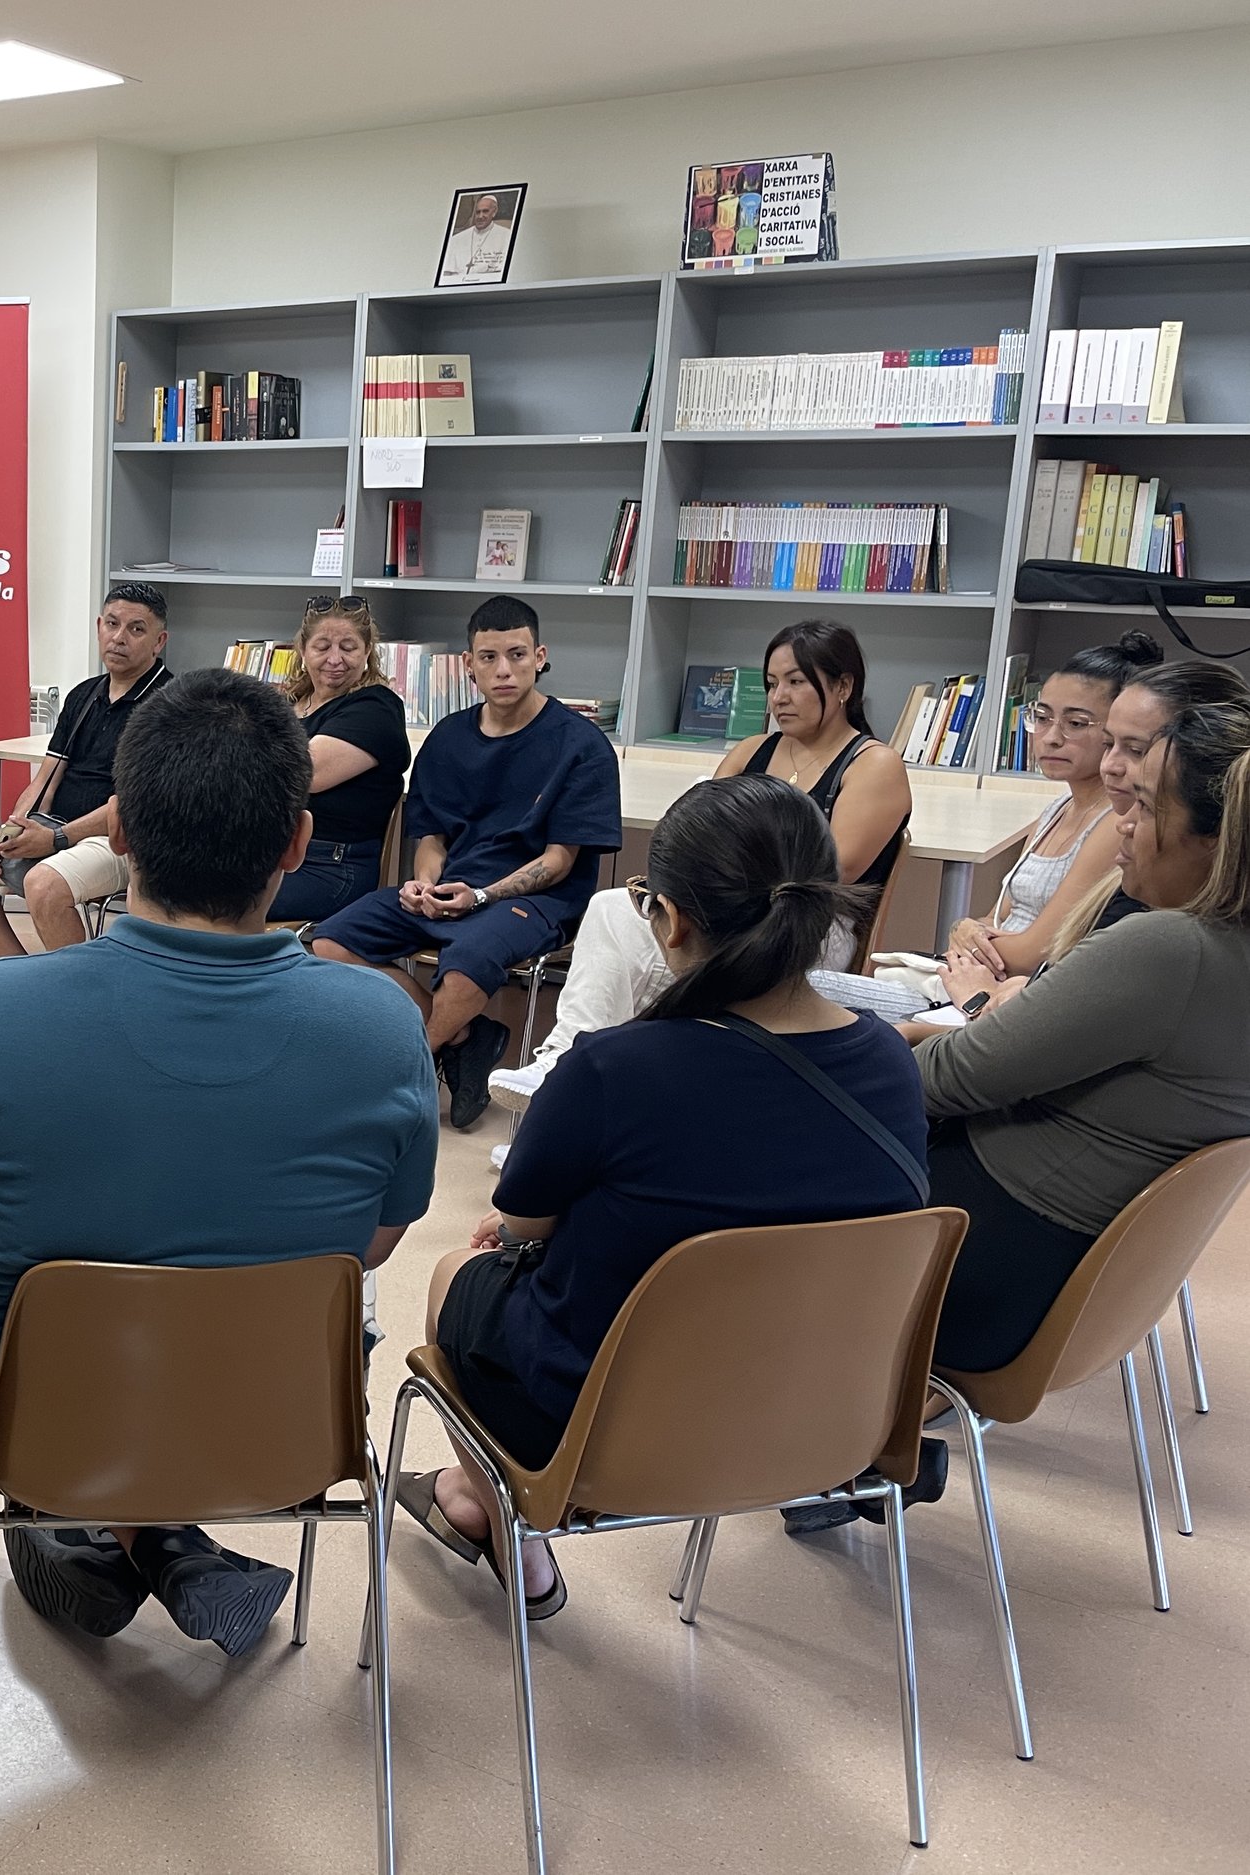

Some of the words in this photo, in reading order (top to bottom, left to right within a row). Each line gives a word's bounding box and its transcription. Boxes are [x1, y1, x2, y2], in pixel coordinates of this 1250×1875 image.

[764, 160, 798, 173] XARXA
[764, 174, 820, 188] D'ENTITATS
[762, 188, 821, 203] CRISTIANES
[761, 203, 800, 218] D'ACCIÓ
[760, 219, 817, 233] CARITATIVA
[765, 234, 803, 246] SOCIAL.
